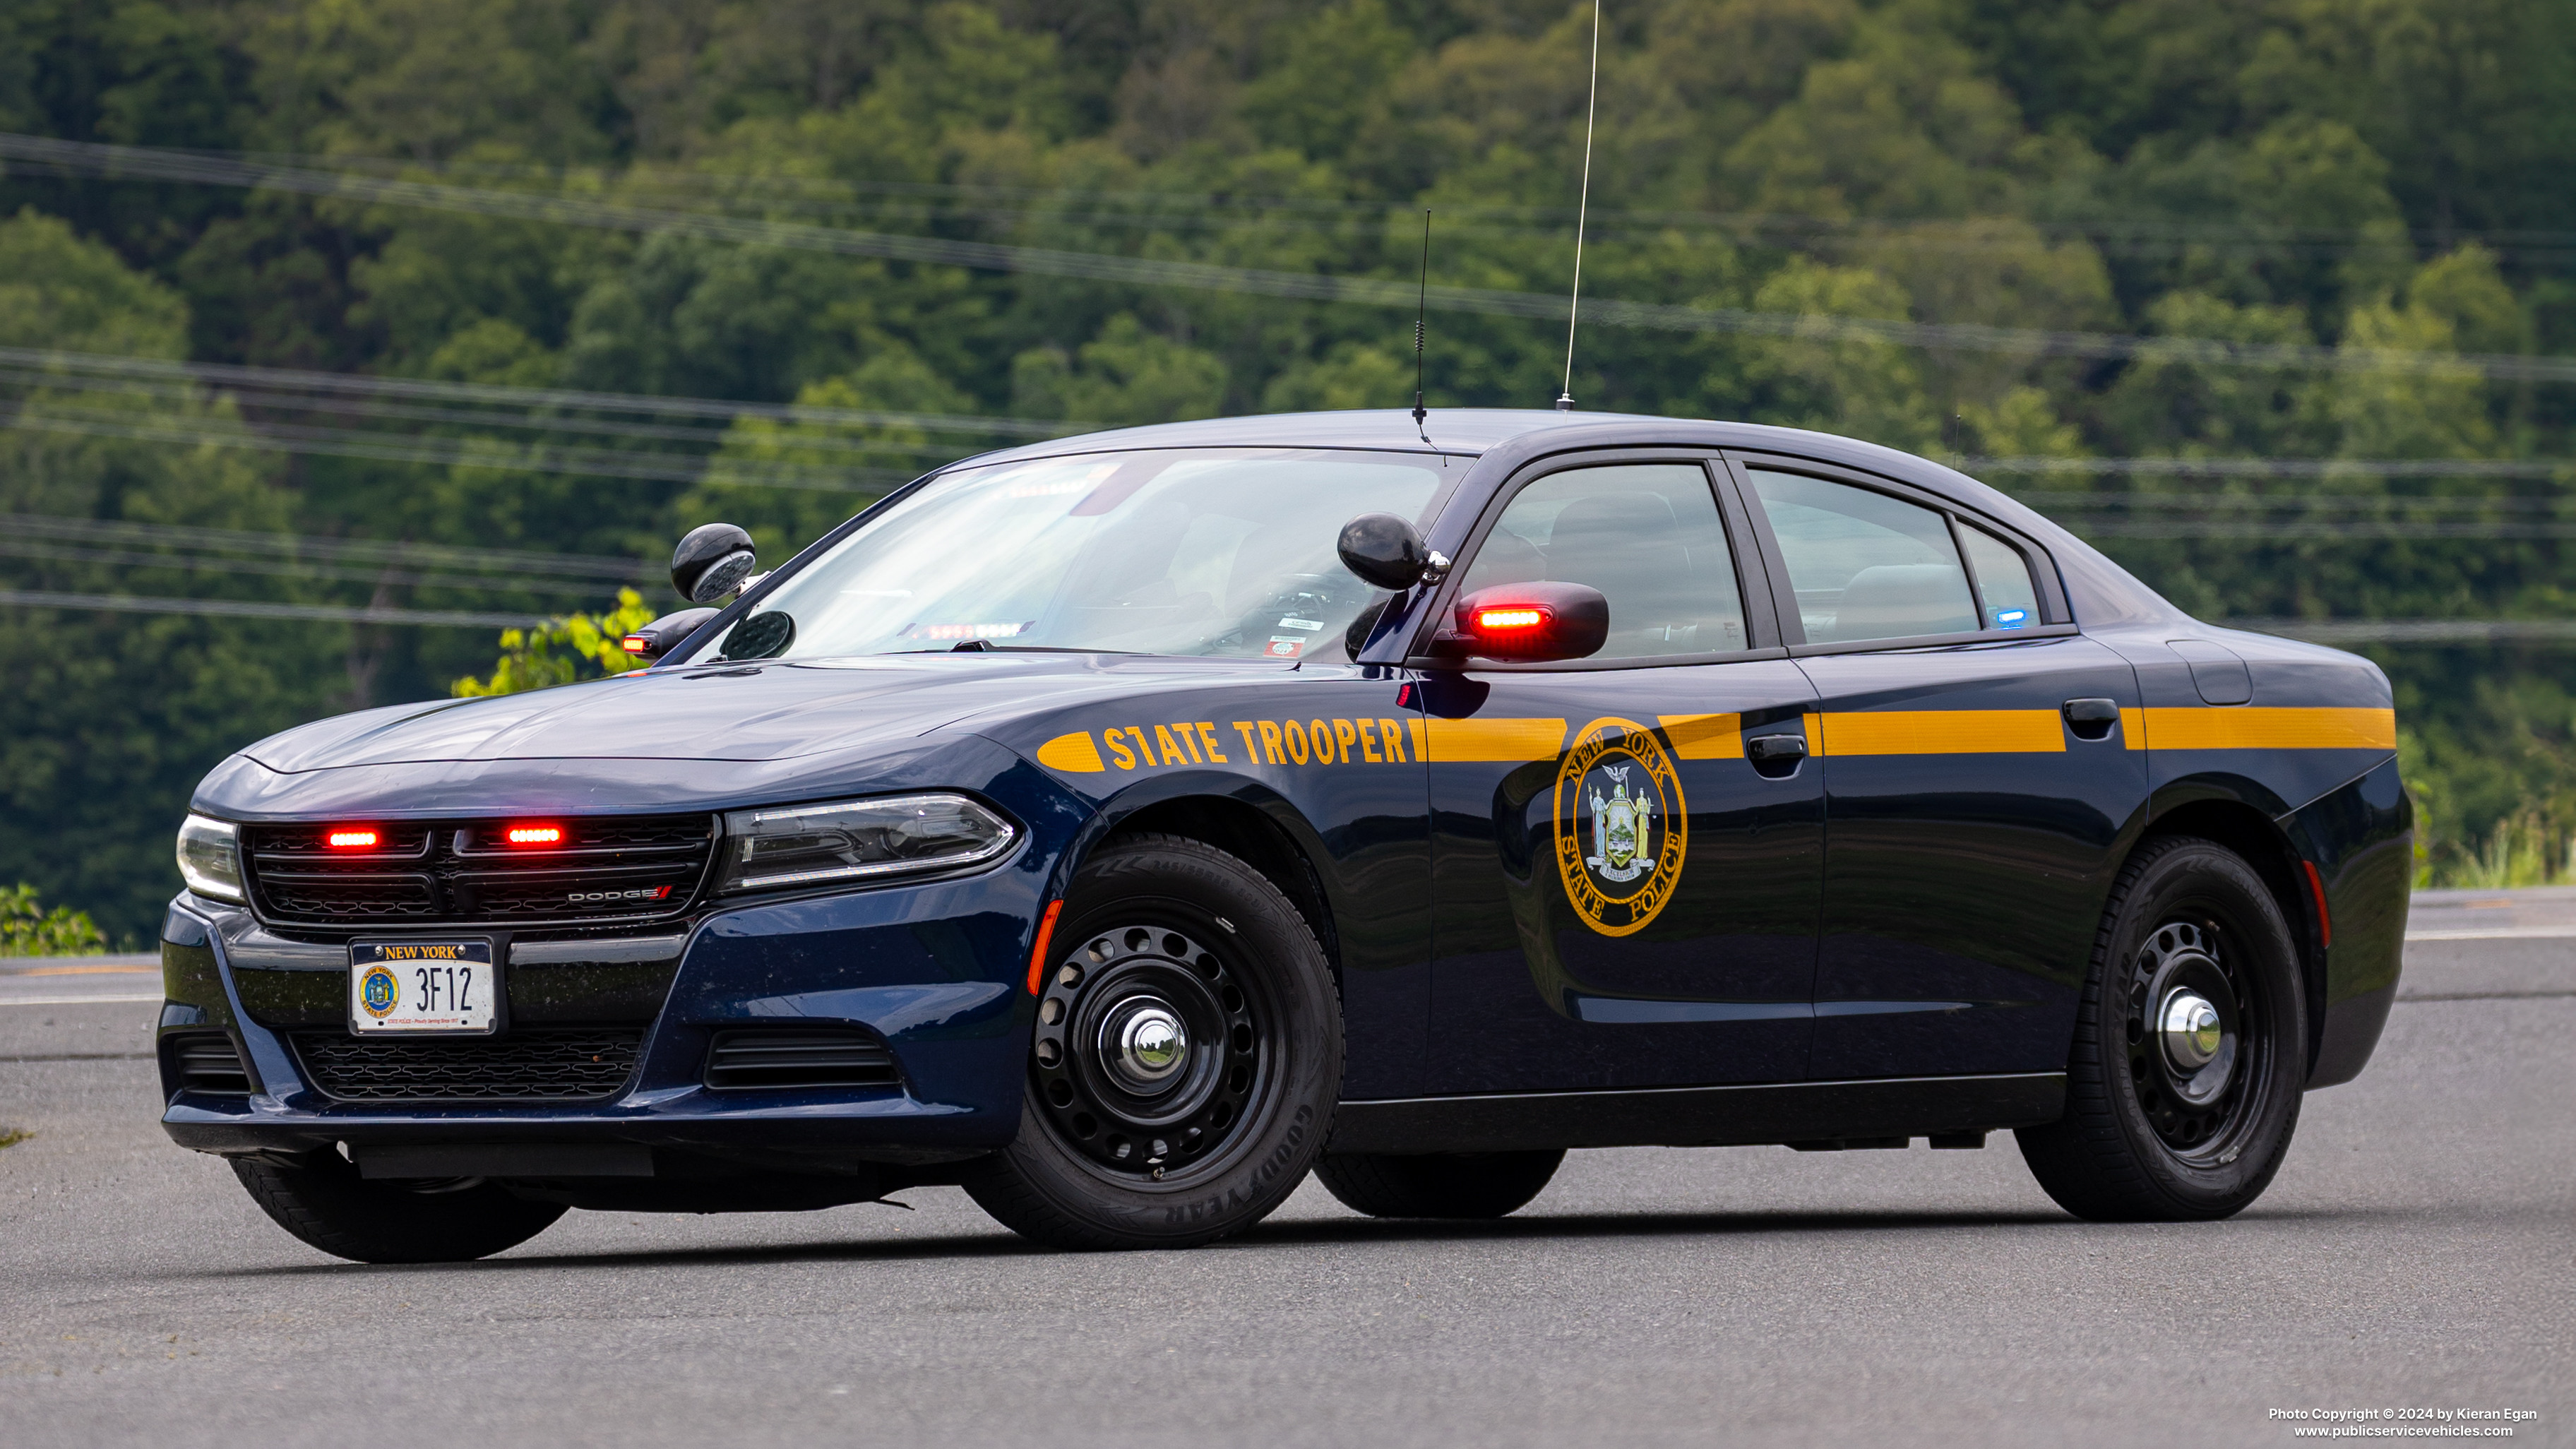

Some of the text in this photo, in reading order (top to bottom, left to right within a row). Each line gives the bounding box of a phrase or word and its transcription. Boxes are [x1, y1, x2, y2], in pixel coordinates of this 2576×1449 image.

[1103, 717, 1407, 771] STATE TROOPER
[1566, 726, 1670, 788] NEW YORK
[1561, 832, 1681, 922] STATE POLICE
[568, 888, 659, 902] DODGE
[385, 946, 457, 960] NEW YORK
[364, 967, 394, 980] NEW YORK
[416, 967, 472, 1011] 3F12
[362, 999, 397, 1017] STATE POLICE
